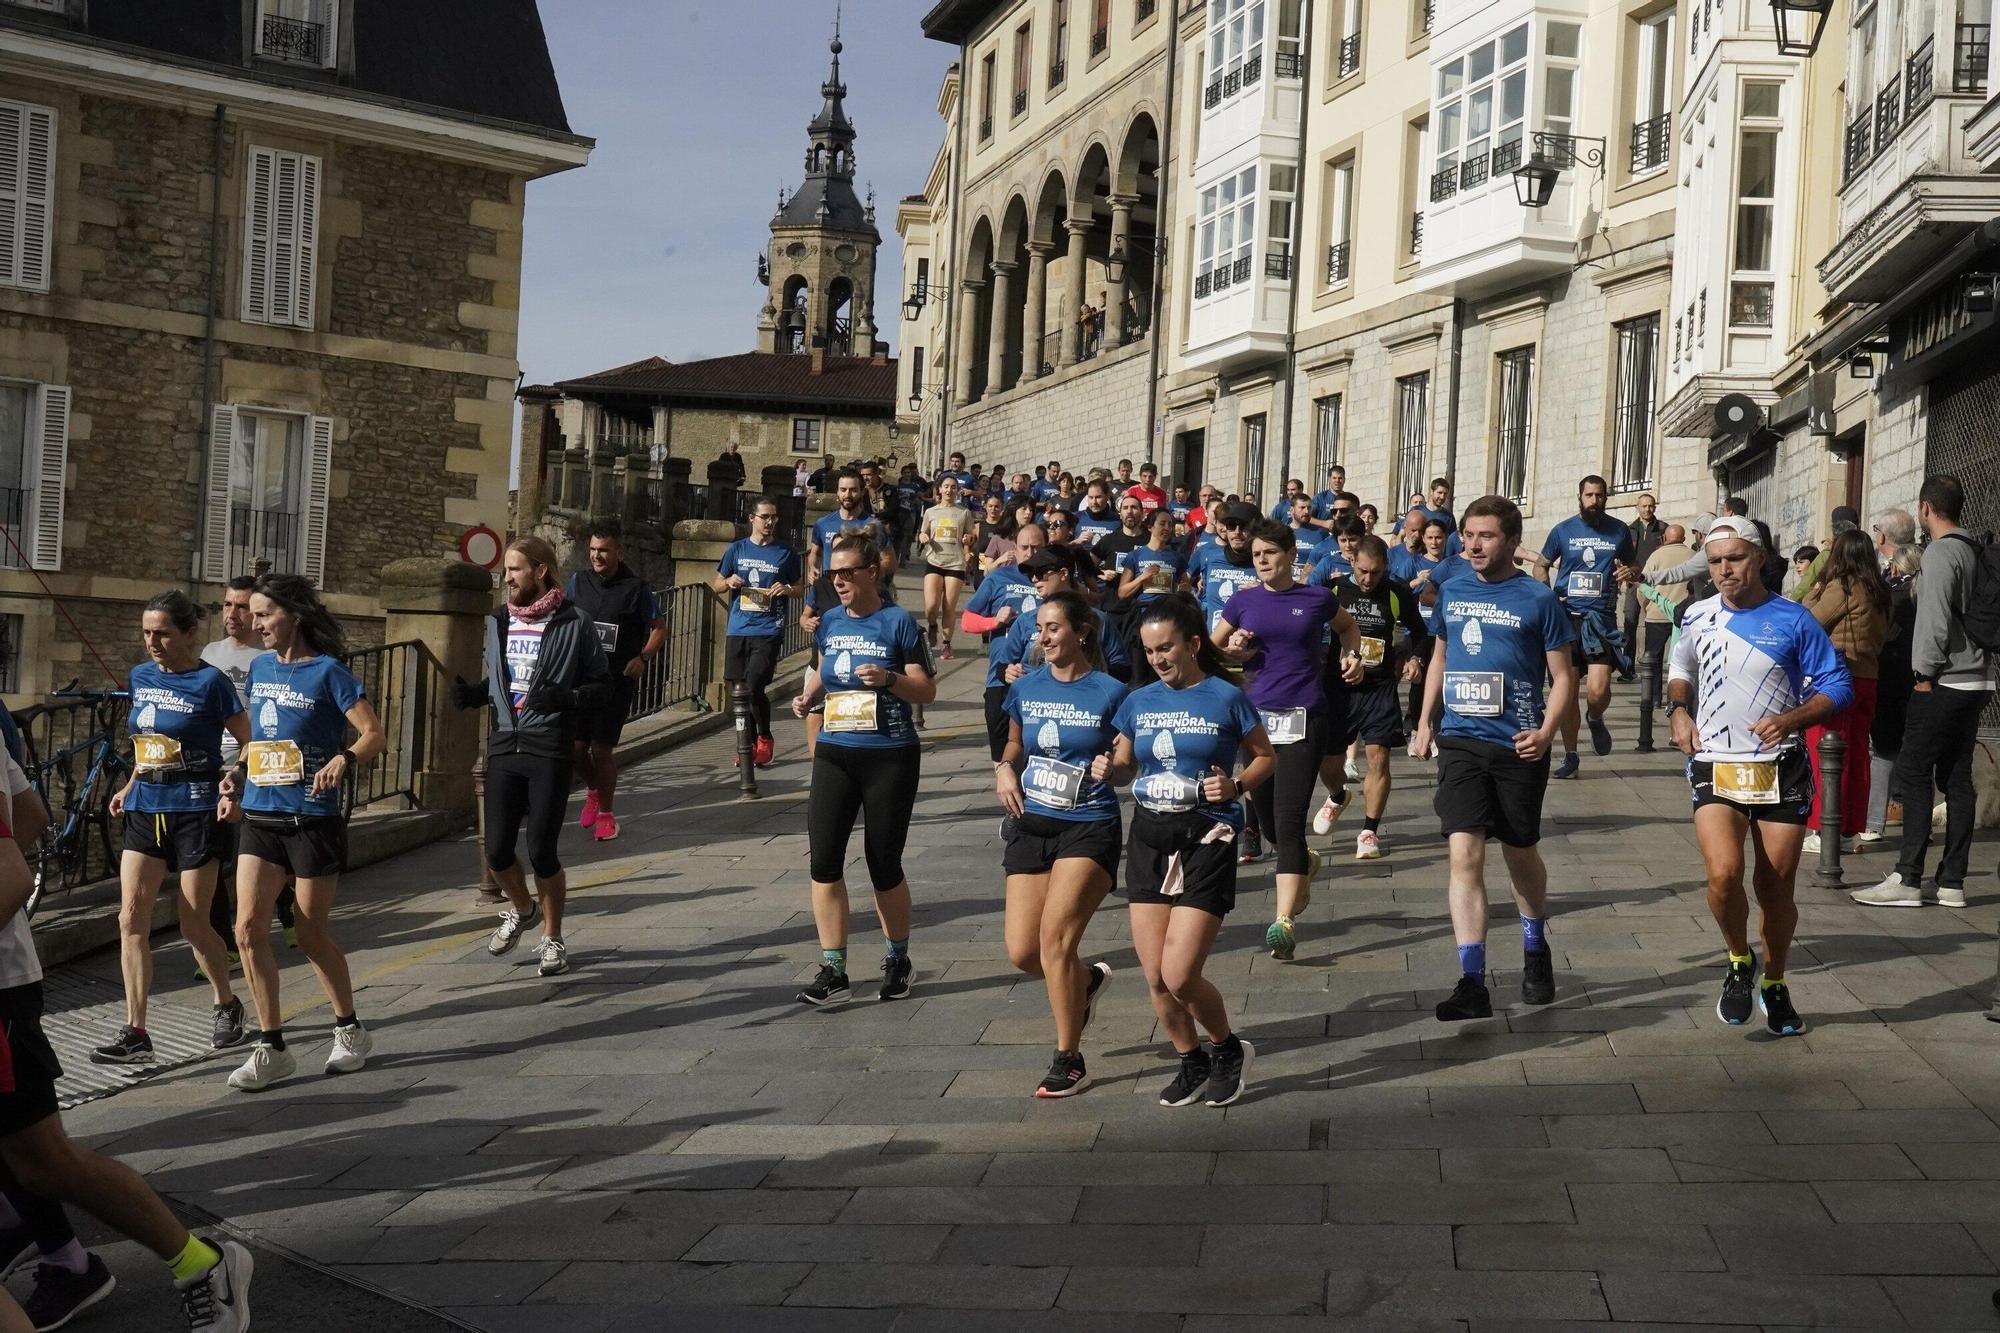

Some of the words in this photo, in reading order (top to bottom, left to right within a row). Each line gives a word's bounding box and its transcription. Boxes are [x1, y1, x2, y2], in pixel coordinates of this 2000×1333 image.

[1836, 452, 1842, 463] 2
[1577, 578, 1593, 588] 941
[1455, 601, 1497, 610] CONQUISTA
[1454, 608, 1511, 619] ALMENDRA
[1481, 617, 1521, 628] KONKISTA
[831, 641, 877, 650] ALMENDRA
[851, 649, 887, 657] KONKISTA
[253, 689, 304, 702] ALMENDRA
[1454, 683, 1491, 700] 1050
[138, 694, 184, 705] ALMENDRA
[276, 699, 315, 710] KONKISTA
[157, 703, 193, 713] KONKISTA
[1030, 701, 1075, 711] CONQUISTA
[1029, 709, 1091, 720] ALMENDRA
[1143, 711, 1190, 720] CONQUISTA
[1059, 719, 1101, 727] KONKISTA
[1143, 717, 1208, 729] ALMENDRA
[1173, 727, 1219, 736] KONKISTA
[259, 751, 287, 769] 287
[1032, 768, 1068, 792] 1060
[1736, 767, 1755, 786] 31
[1145, 779, 1185, 800] 1058
